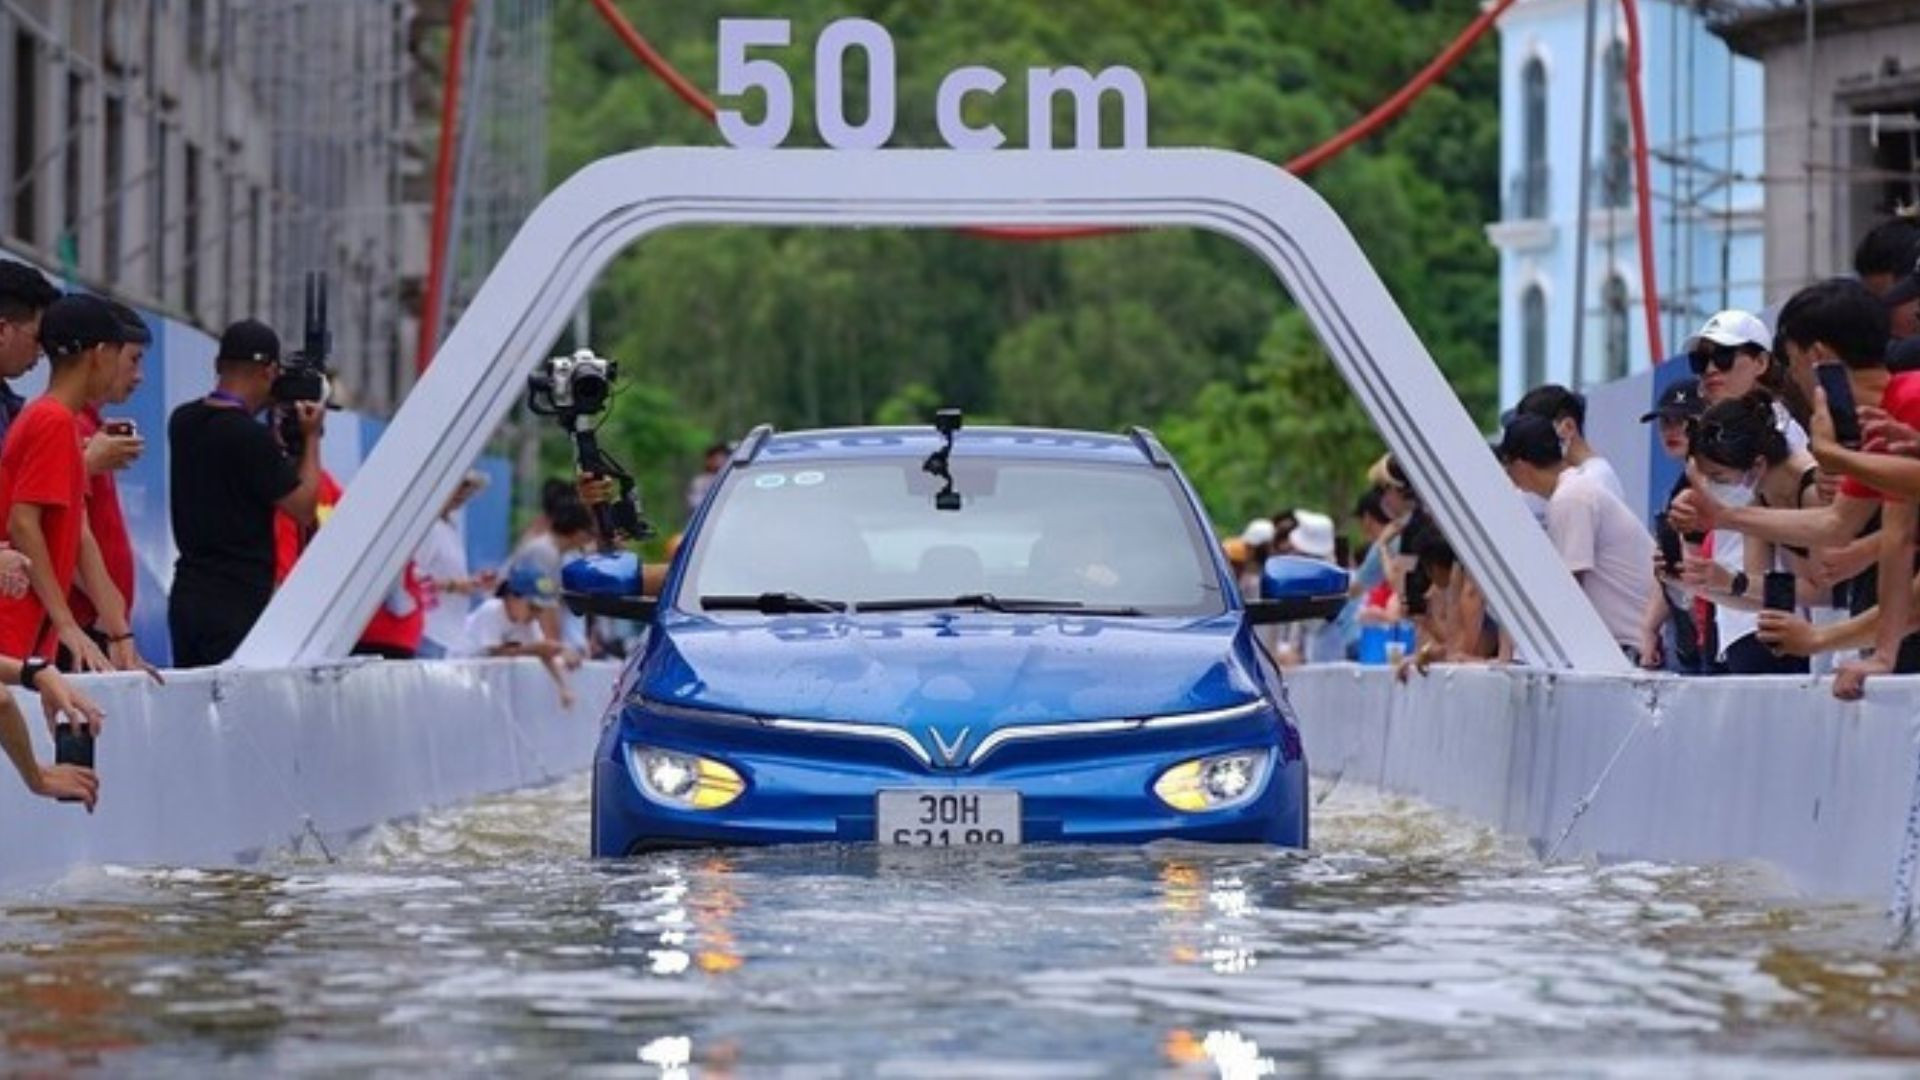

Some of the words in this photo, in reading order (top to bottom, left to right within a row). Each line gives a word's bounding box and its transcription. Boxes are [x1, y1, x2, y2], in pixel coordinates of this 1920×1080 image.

[716, 17, 896, 150] 50
[936, 65, 1148, 150] cm
[918, 794, 980, 825] 30H
